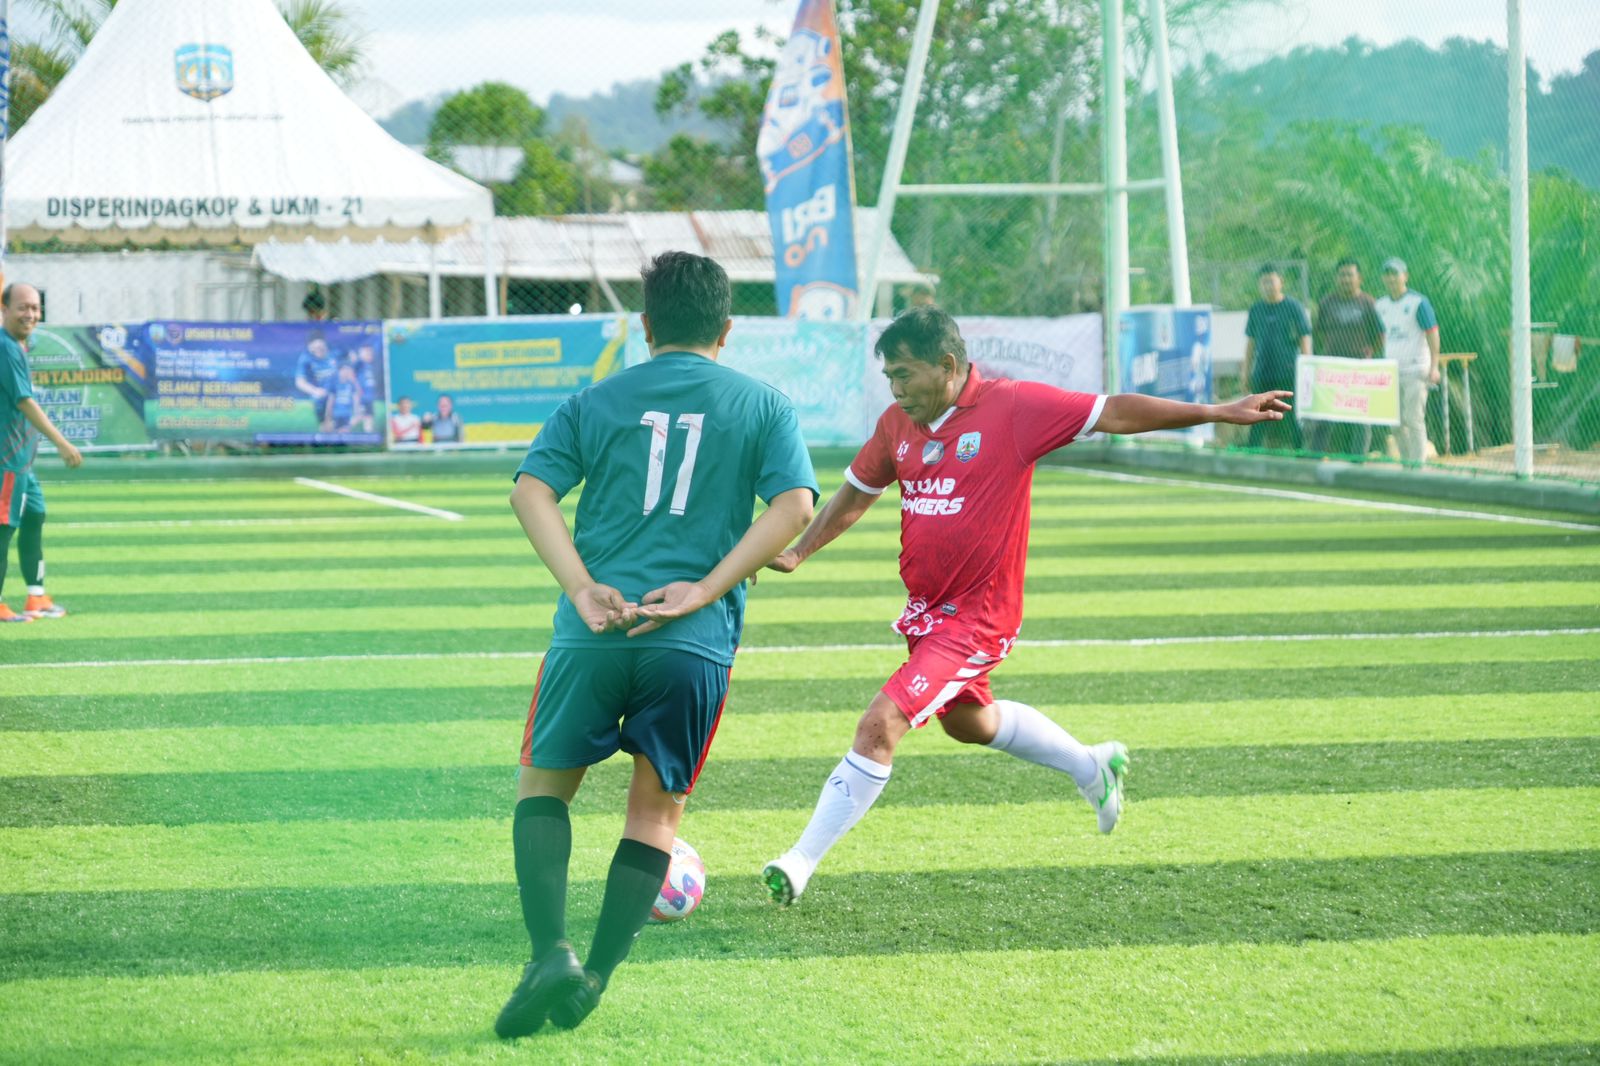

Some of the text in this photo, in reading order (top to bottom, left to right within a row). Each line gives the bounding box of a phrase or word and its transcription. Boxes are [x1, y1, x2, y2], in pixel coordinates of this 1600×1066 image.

[47, 197, 239, 218] DISPERINDAGKOP
[248, 199, 262, 216] &
[271, 197, 319, 216] UKM
[341, 196, 363, 215] 21
[31, 367, 125, 385] ERTANDING
[640, 410, 706, 516] 11
